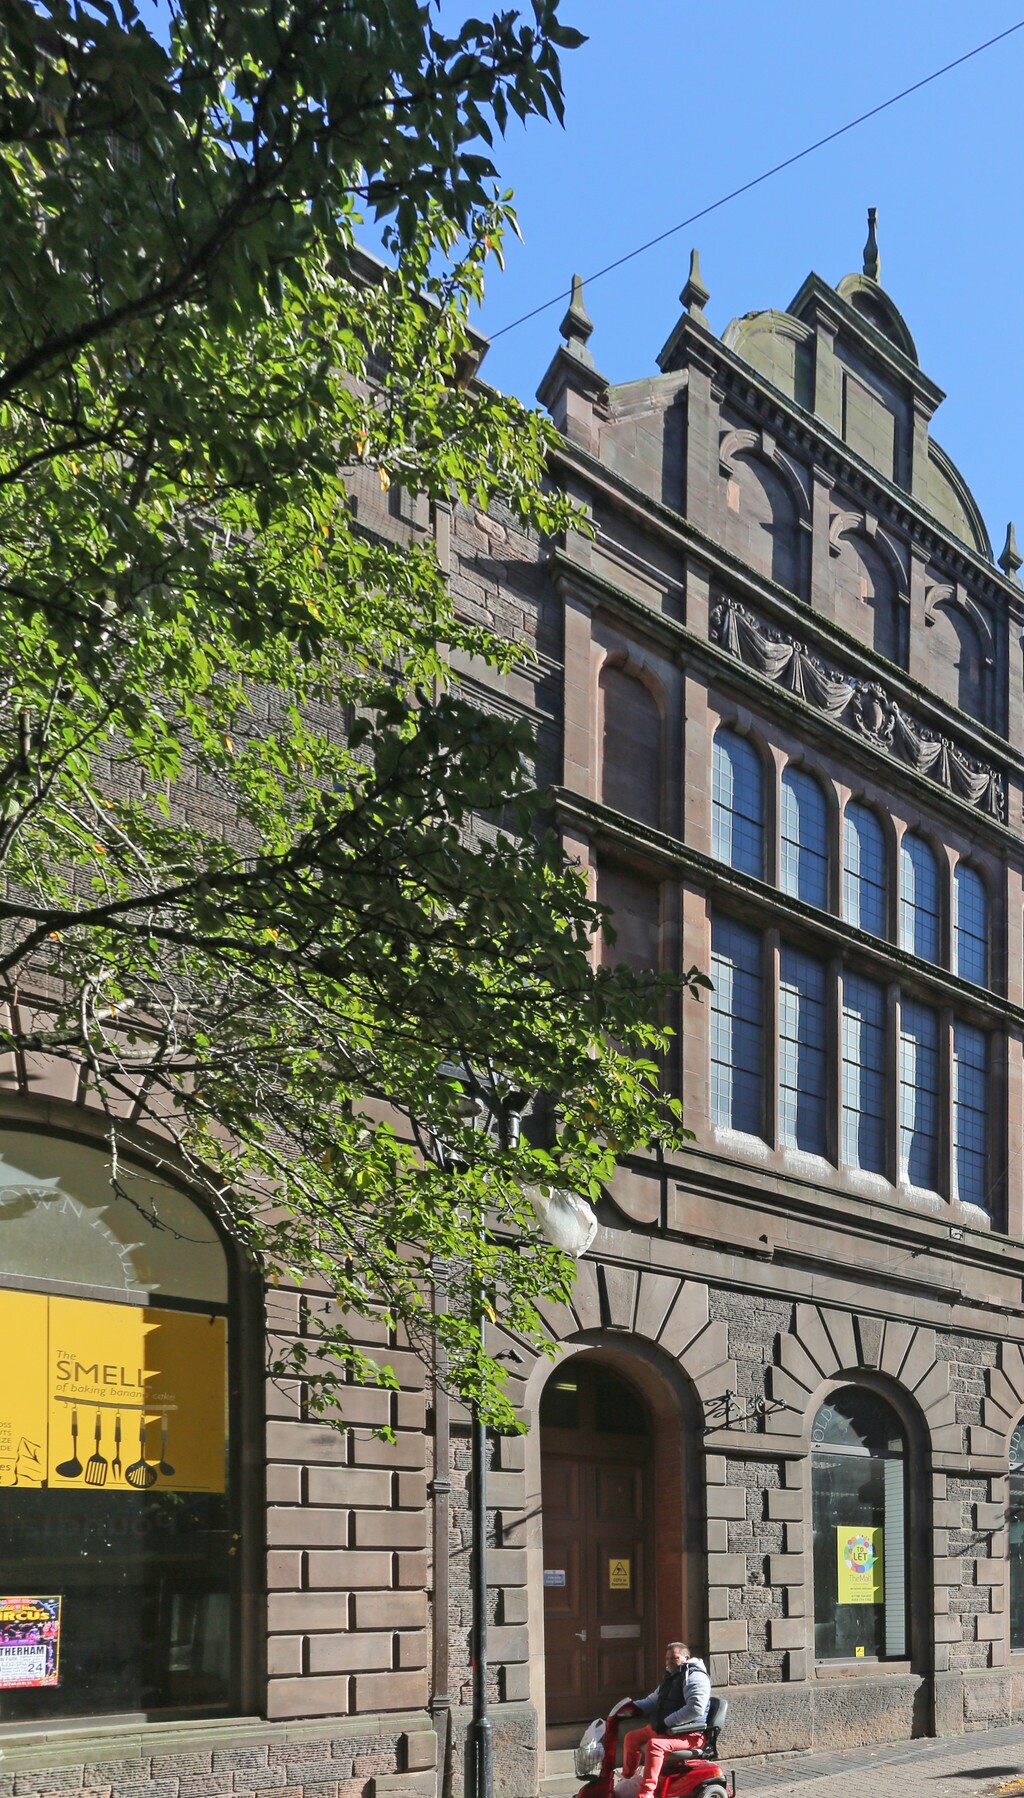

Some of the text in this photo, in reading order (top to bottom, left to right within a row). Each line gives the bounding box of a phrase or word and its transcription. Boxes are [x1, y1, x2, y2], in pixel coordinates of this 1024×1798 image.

[56, 1350, 77, 1360] The
[56, 1360, 153, 1389] SMELL
[56, 1383, 177, 1401] of baking banana cake
[812, 1408, 833, 1442] OLD
[1008, 1432, 1021, 1462] OLD
[853, 1553, 867, 1561] LET
[27, 1663, 43, 1673] 24
